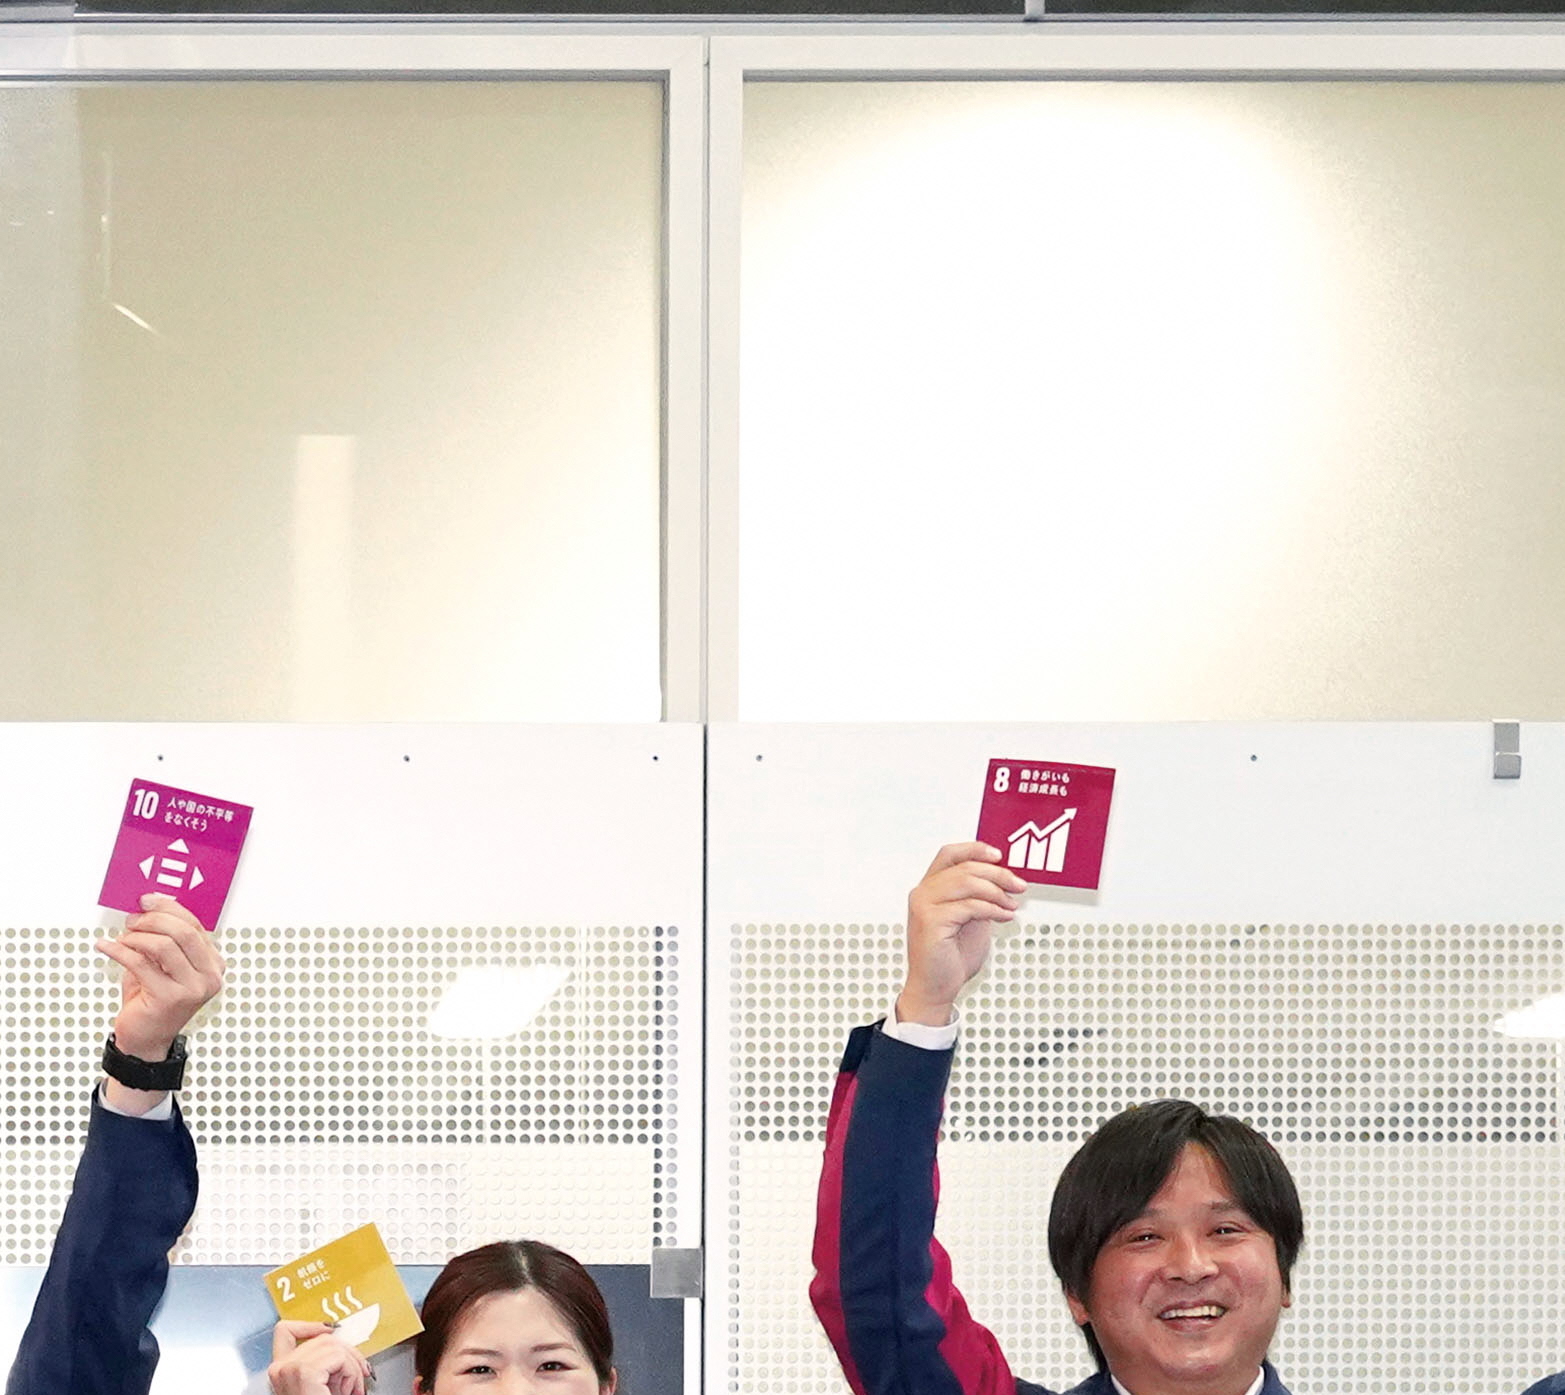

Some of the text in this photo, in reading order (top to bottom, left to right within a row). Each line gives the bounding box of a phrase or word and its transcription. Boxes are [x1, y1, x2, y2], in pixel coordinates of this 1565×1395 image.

[993, 766, 1010, 793] 8
[132, 788, 160, 820] 10
[167, 797, 234, 823] 人や国の不平等
[164, 813, 207, 832] をなくそう
[276, 1276, 295, 1303] 2
[302, 1271, 331, 1290] ゼロに
